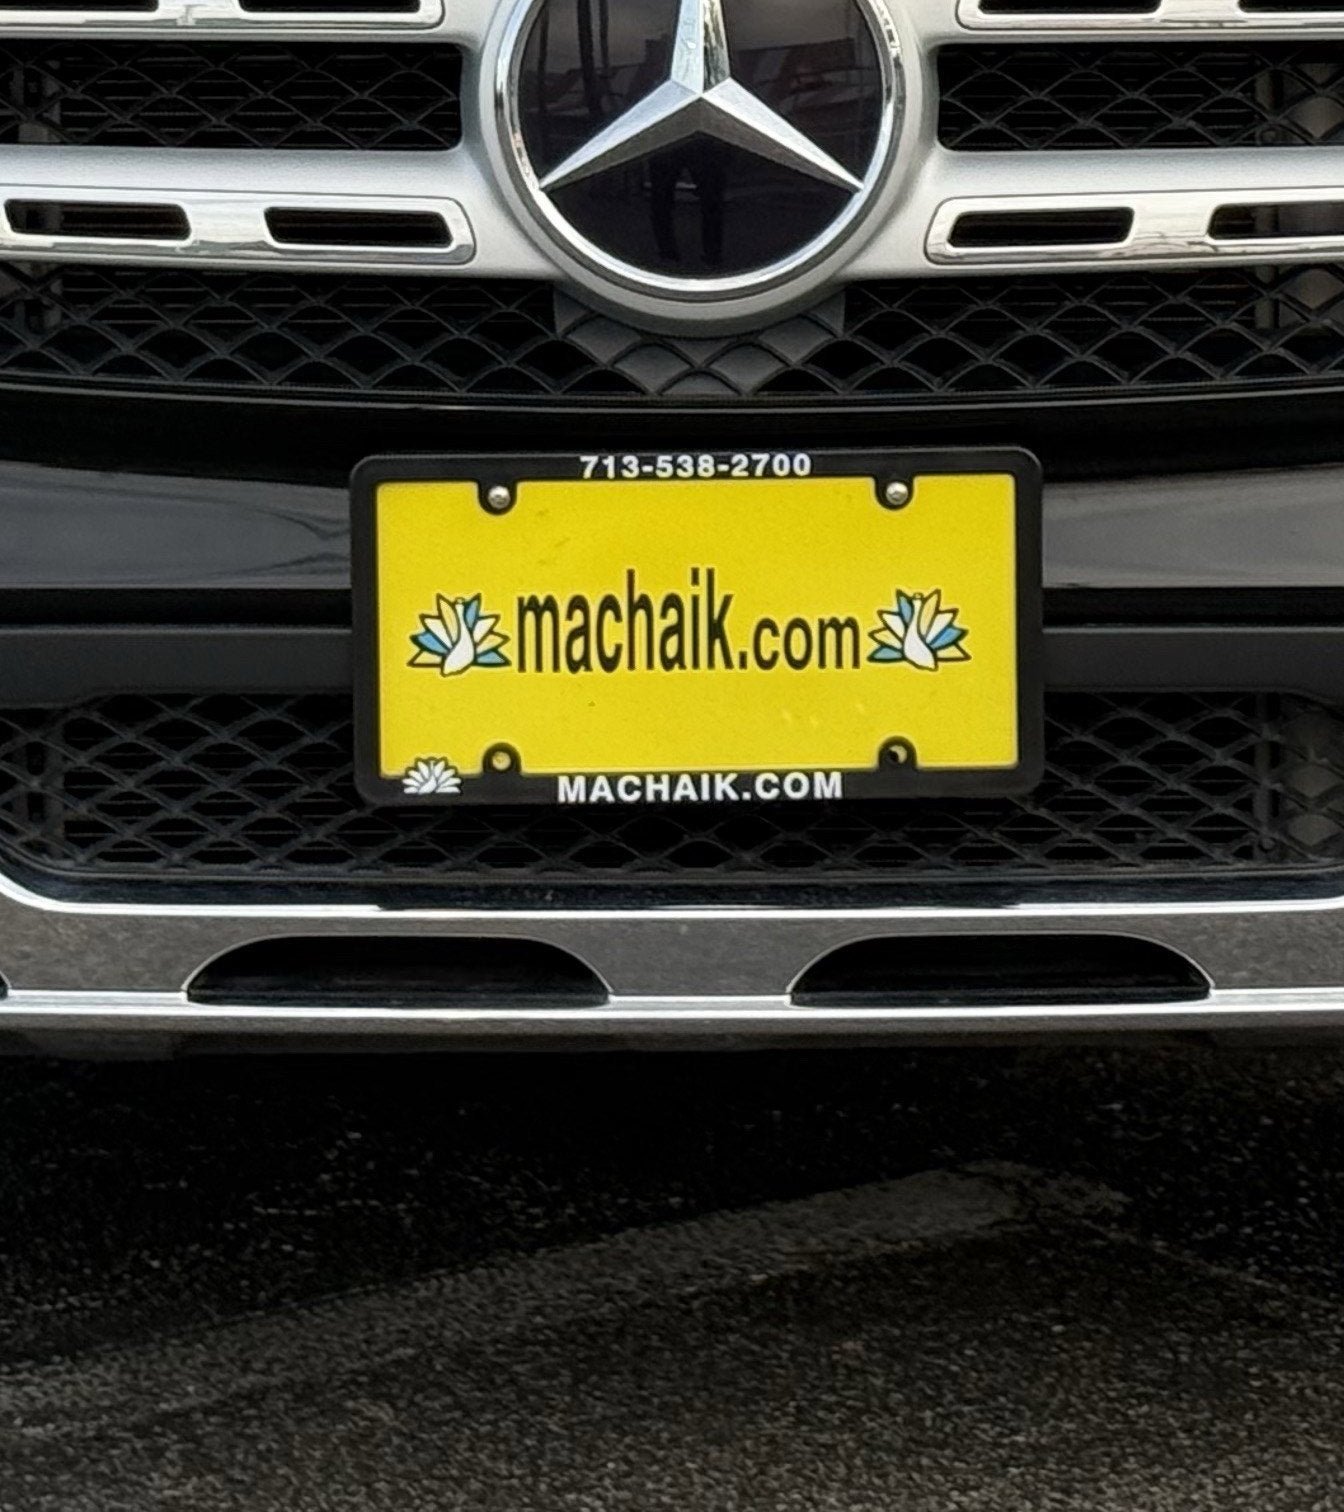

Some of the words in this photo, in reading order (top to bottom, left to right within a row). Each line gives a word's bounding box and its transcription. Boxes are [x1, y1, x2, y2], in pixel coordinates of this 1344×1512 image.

[579, 452, 812, 480] 713-538-2700
[517, 566, 861, 675] machaik.com
[557, 771, 844, 803] MACHAIK.COM
